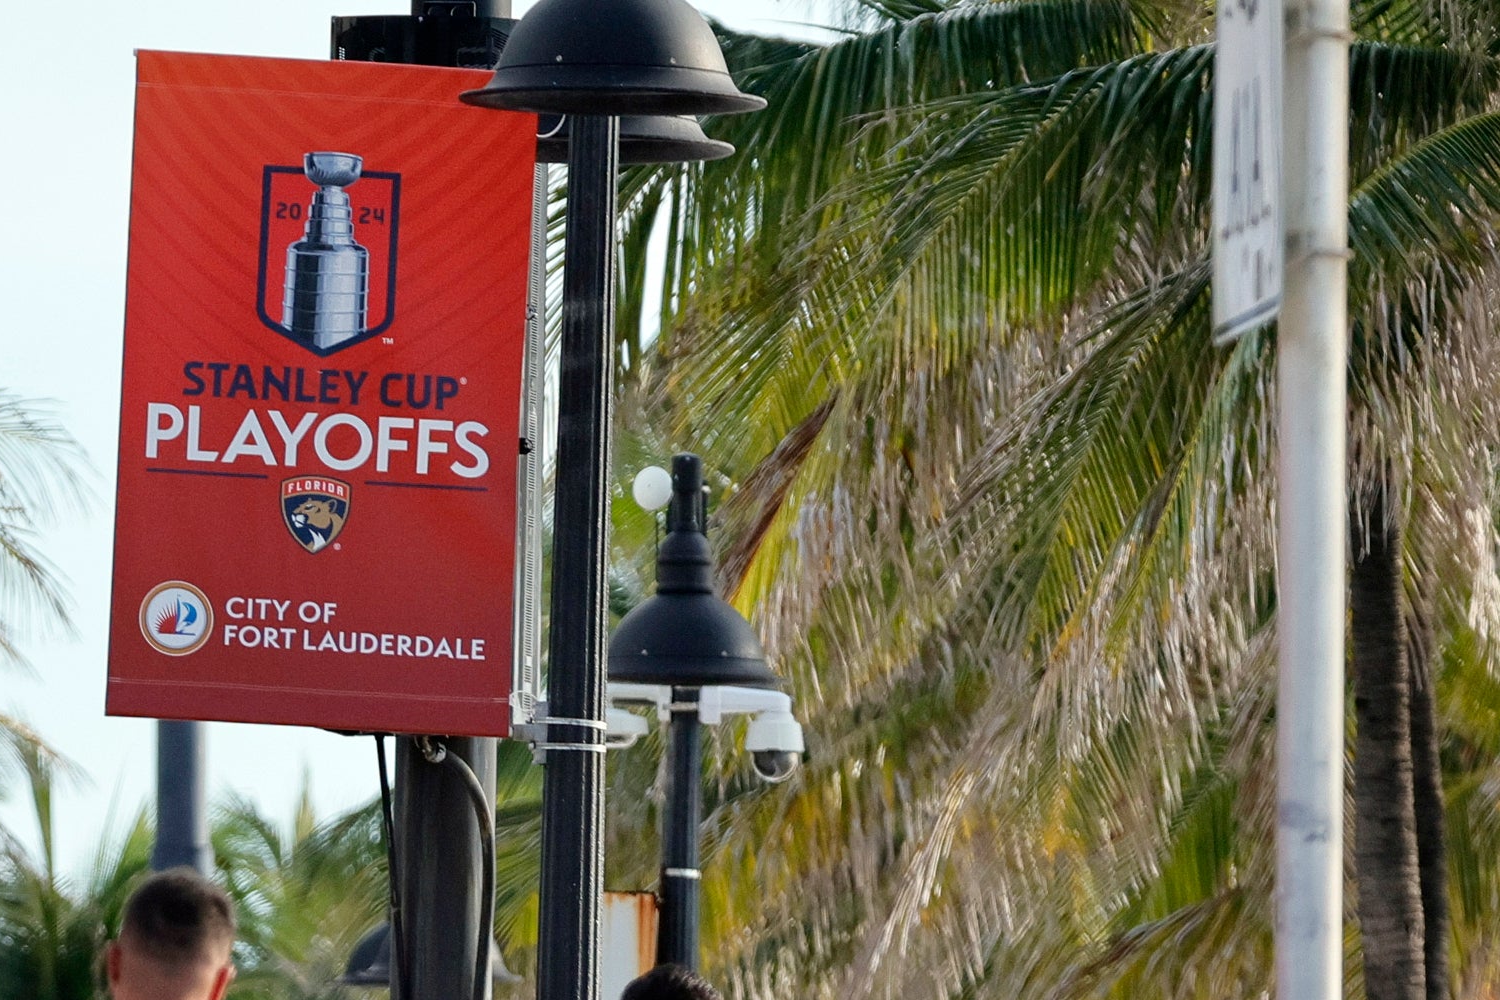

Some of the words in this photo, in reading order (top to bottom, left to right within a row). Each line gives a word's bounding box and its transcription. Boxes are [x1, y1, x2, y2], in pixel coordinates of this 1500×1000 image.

[276, 202, 301, 220] 20
[359, 206, 385, 224] 24
[182, 361, 369, 406] STANLEY
[380, 372, 459, 410] CUP
[145, 402, 490, 479] PLAYOFFS
[288, 480, 344, 497] FLORIDA
[225, 597, 291, 621] CITY
[298, 601, 337, 624] OF
[223, 625, 296, 650] FORT
[302, 629, 486, 661] LAUDERDALE
